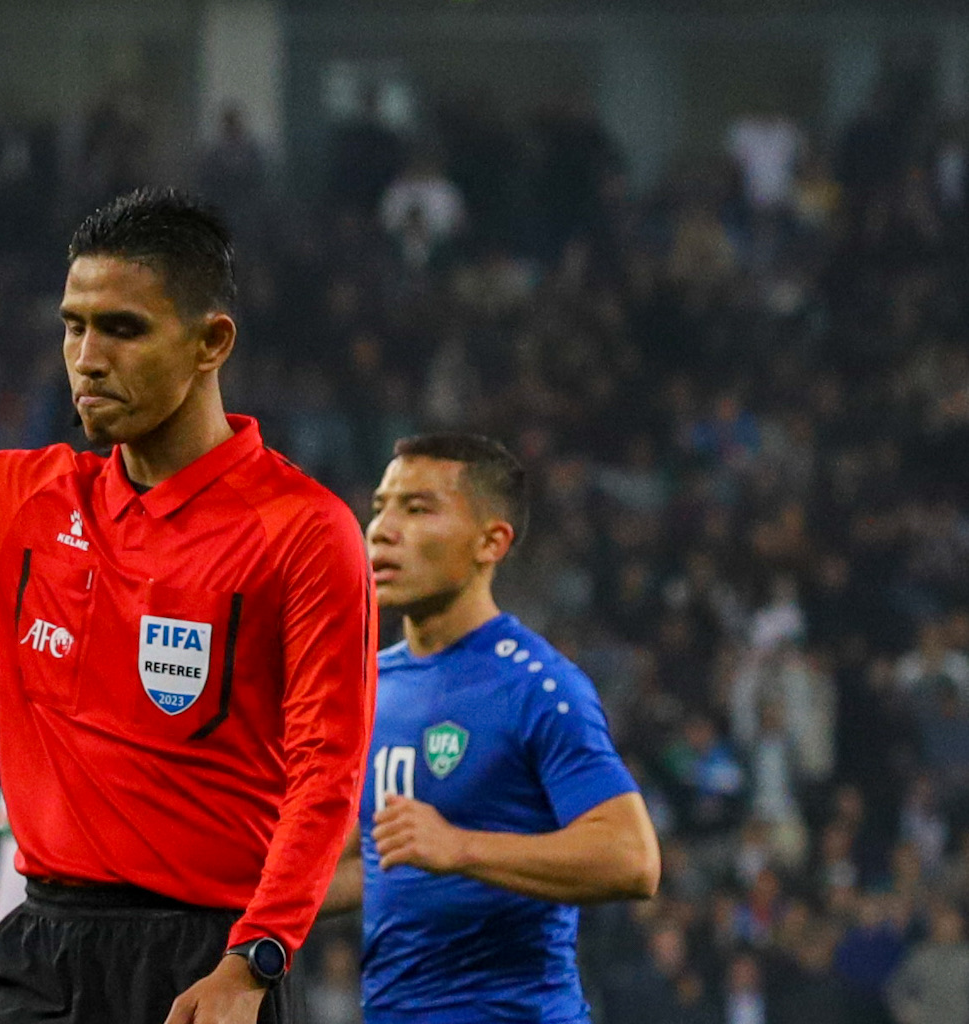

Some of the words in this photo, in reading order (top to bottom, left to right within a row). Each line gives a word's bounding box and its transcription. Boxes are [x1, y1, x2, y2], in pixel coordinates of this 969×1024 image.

[57, 532, 90, 551] KELME
[20, 618, 73, 658] AFC
[146, 623, 203, 651] FIFA
[144, 660, 202, 679] REFEREE
[158, 693, 185, 707] 2023
[428, 733, 460, 754] UFA
[374, 746, 416, 812] 10
